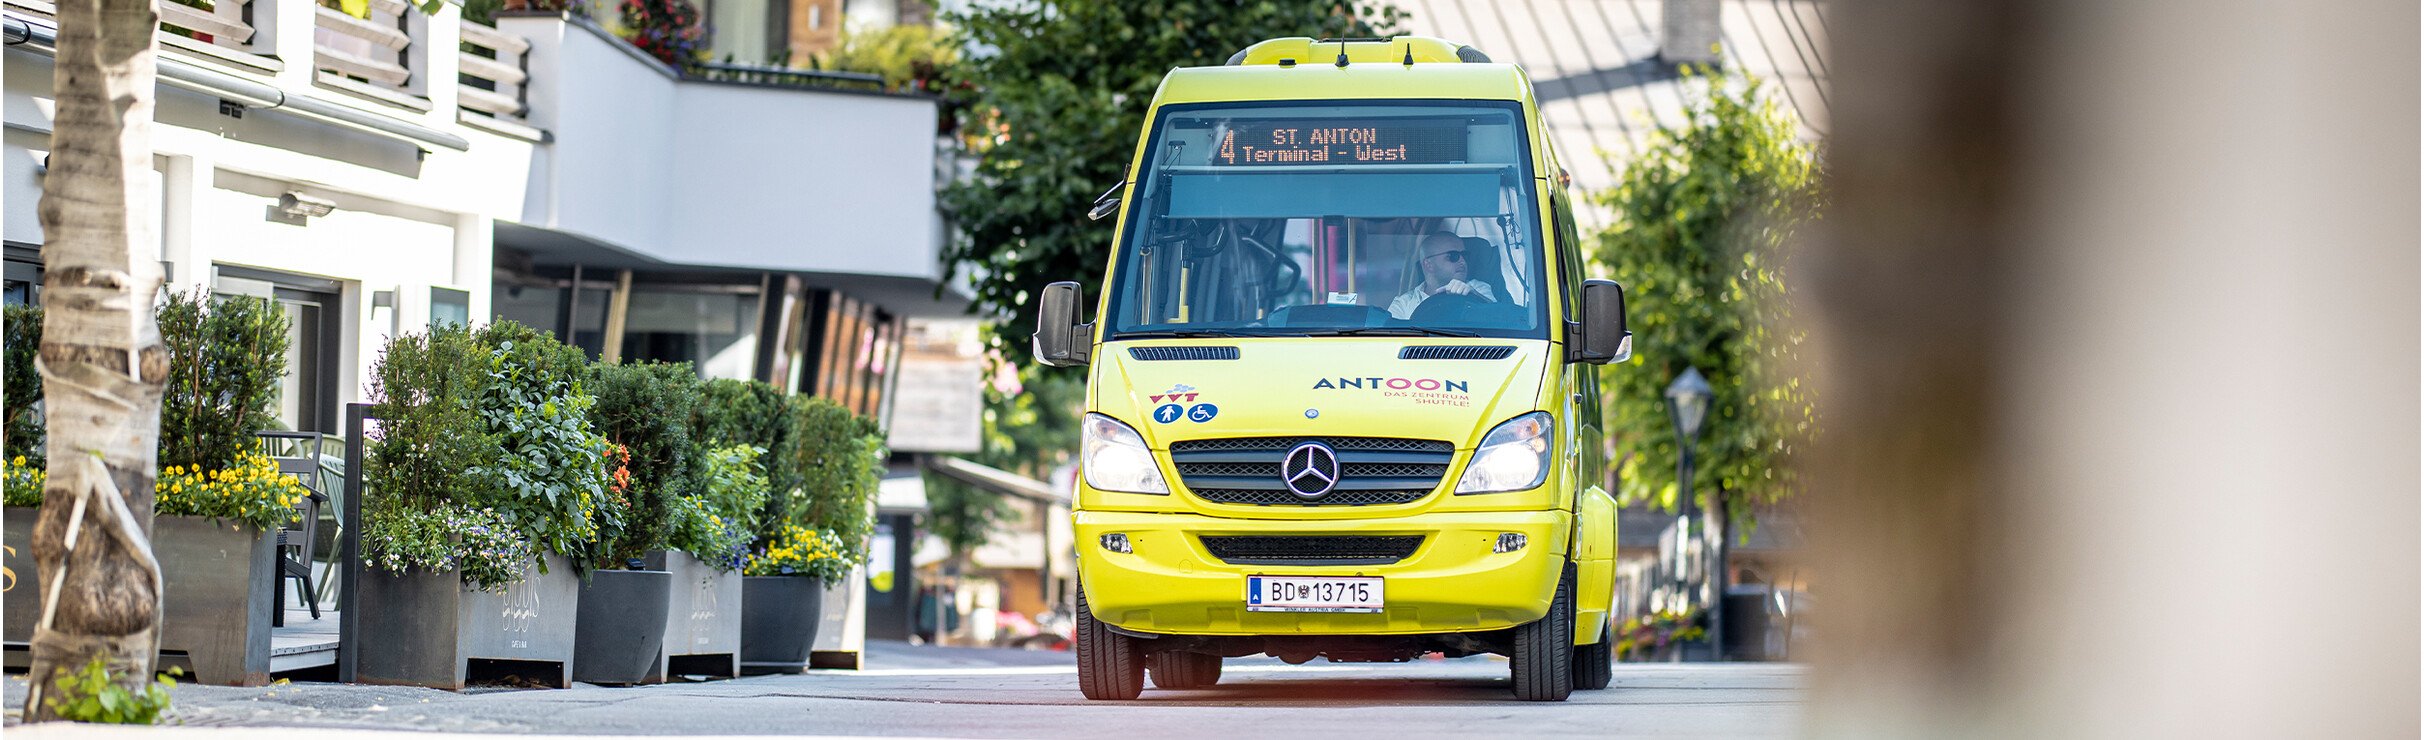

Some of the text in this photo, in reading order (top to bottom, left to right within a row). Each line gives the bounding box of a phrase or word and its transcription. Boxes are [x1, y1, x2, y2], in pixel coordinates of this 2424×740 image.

[1273, 128, 1376, 145] ST. ANTON
[1220, 129, 1236, 165] 4
[1242, 145, 1329, 162] Terminal
[1355, 144, 1407, 161] West
[1312, 377, 1468, 394] ANTOON
[1149, 392, 1199, 404] VVT
[1411, 391, 1469, 401] ZENTRUM
[1415, 398, 1470, 408] SHUTTLE!
[1272, 582, 1369, 602] BD 13715
